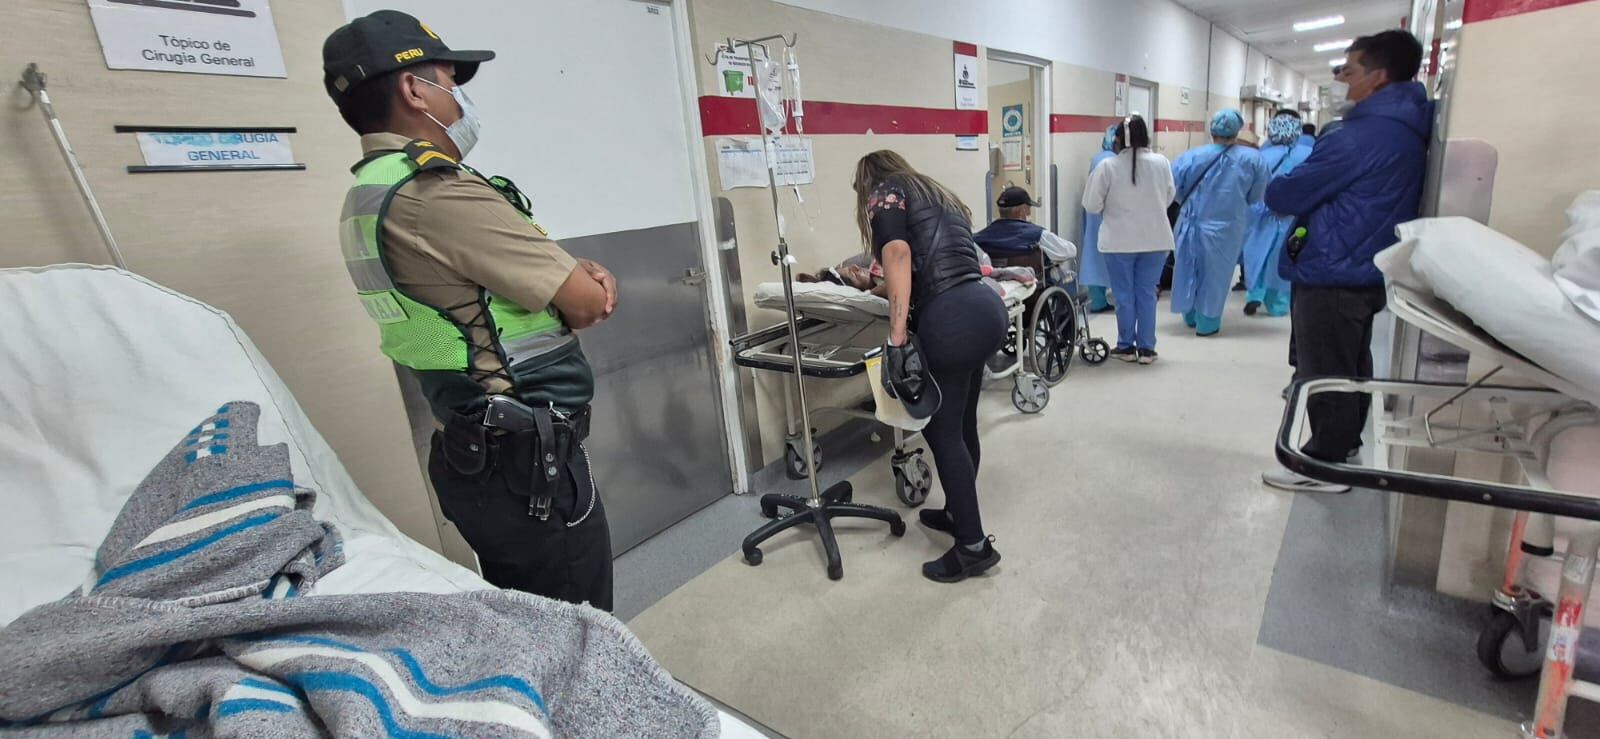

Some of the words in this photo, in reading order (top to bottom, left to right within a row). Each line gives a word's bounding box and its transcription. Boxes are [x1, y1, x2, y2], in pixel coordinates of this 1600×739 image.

[158, 34, 210, 50] Tópico
[213, 40, 232, 51] de
[200, 53, 256, 67] General
[394, 47, 424, 63] PERU
[187, 150, 261, 162] GENERAL
